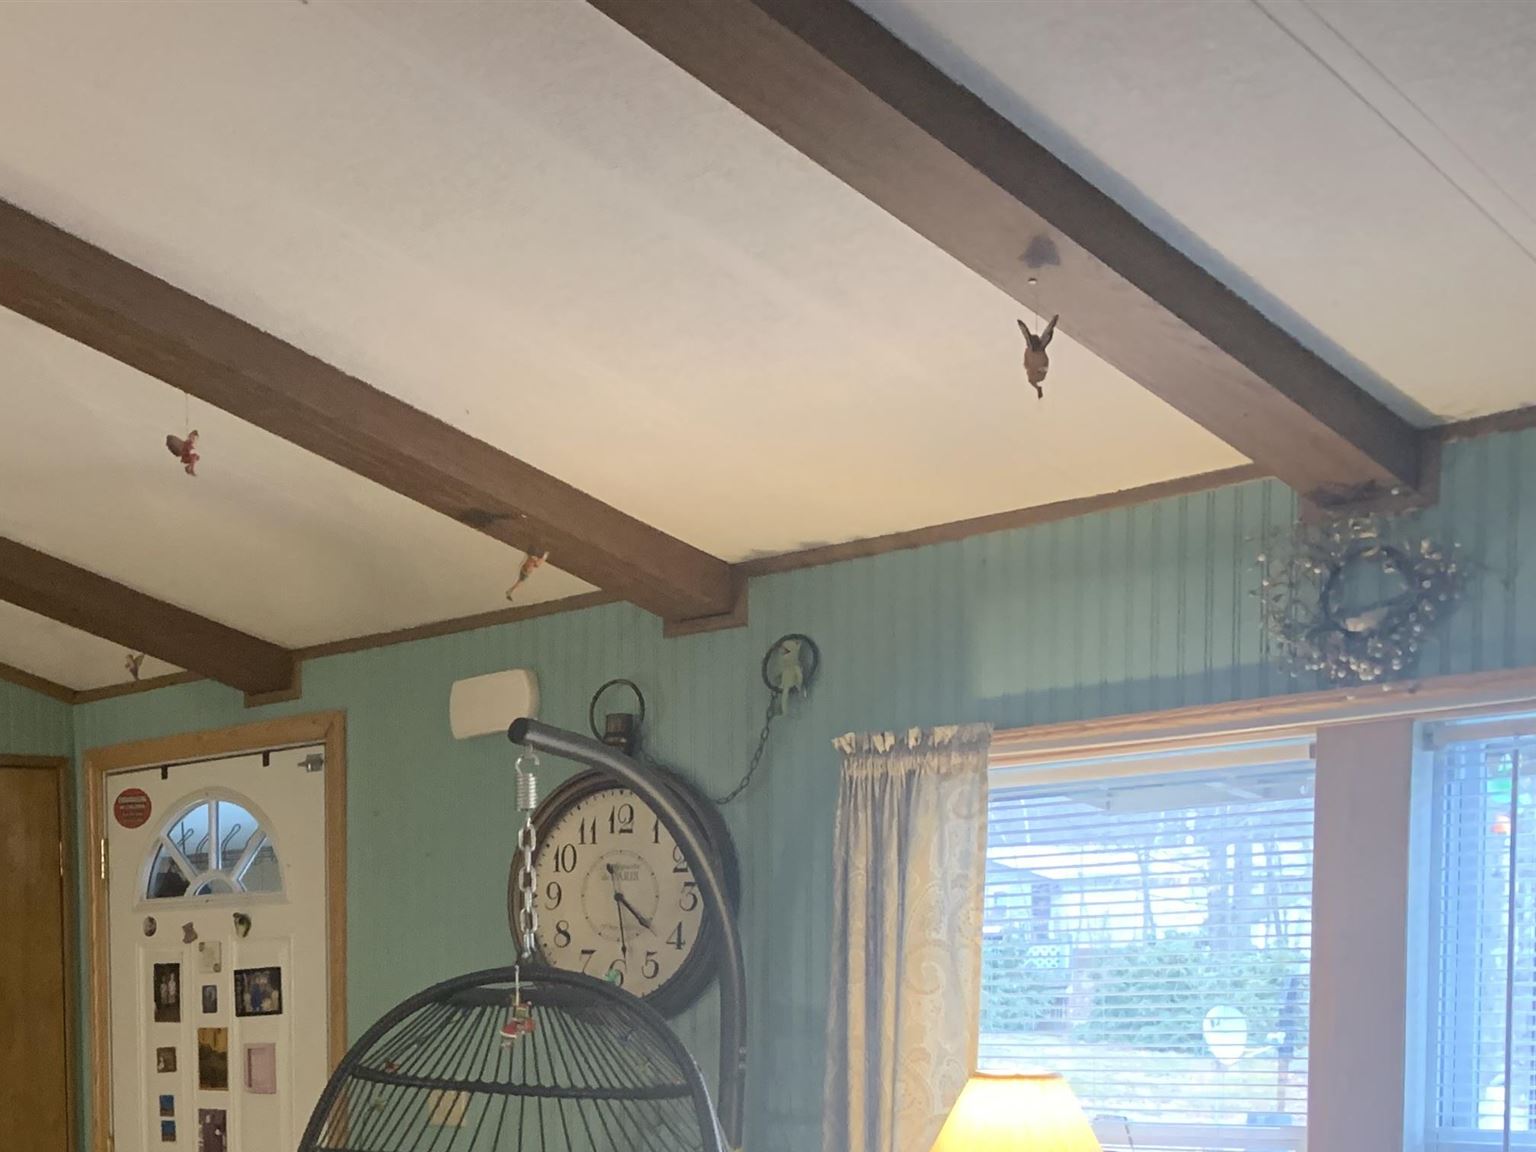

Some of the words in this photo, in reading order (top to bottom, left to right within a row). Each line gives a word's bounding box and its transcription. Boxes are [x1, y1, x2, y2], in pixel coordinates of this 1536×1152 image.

[578, 816, 598, 845] 11
[608, 803, 635, 834] 12
[652, 819, 661, 844] 1
[553, 844, 577, 873] 10
[672, 846, 689, 873] 2
[545, 881, 563, 911] 9
[679, 882, 698, 911] 3
[554, 920, 571, 948] 8
[666, 921, 686, 950] 4
[579, 949, 596, 974] 7
[608, 959, 624, 986] 6
[641, 951, 660, 979] 5
